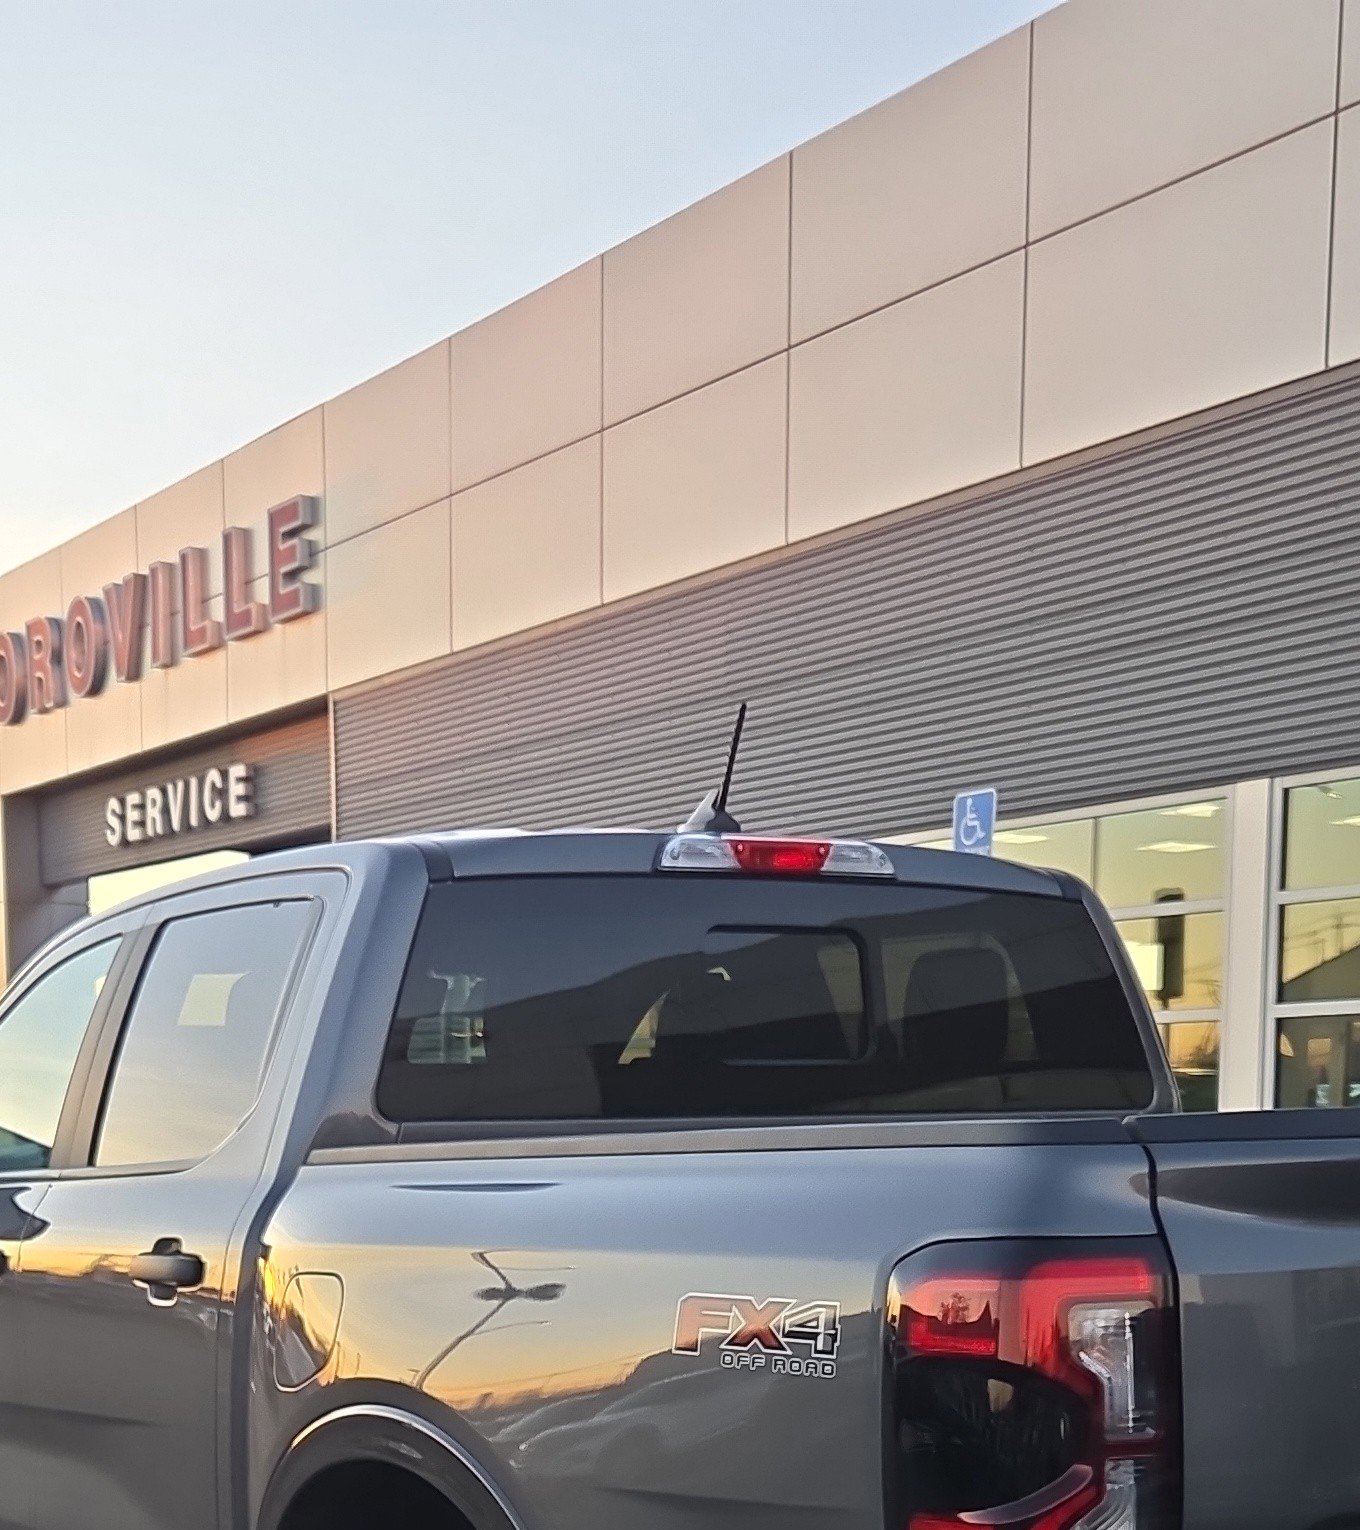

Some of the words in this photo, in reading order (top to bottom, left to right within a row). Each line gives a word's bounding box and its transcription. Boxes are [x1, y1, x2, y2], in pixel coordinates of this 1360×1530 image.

[105, 763, 254, 847] SERVICE
[672, 1292, 841, 1359] FX4
[720, 1350, 766, 1371] OFF
[771, 1355, 837, 1379] ROAD
